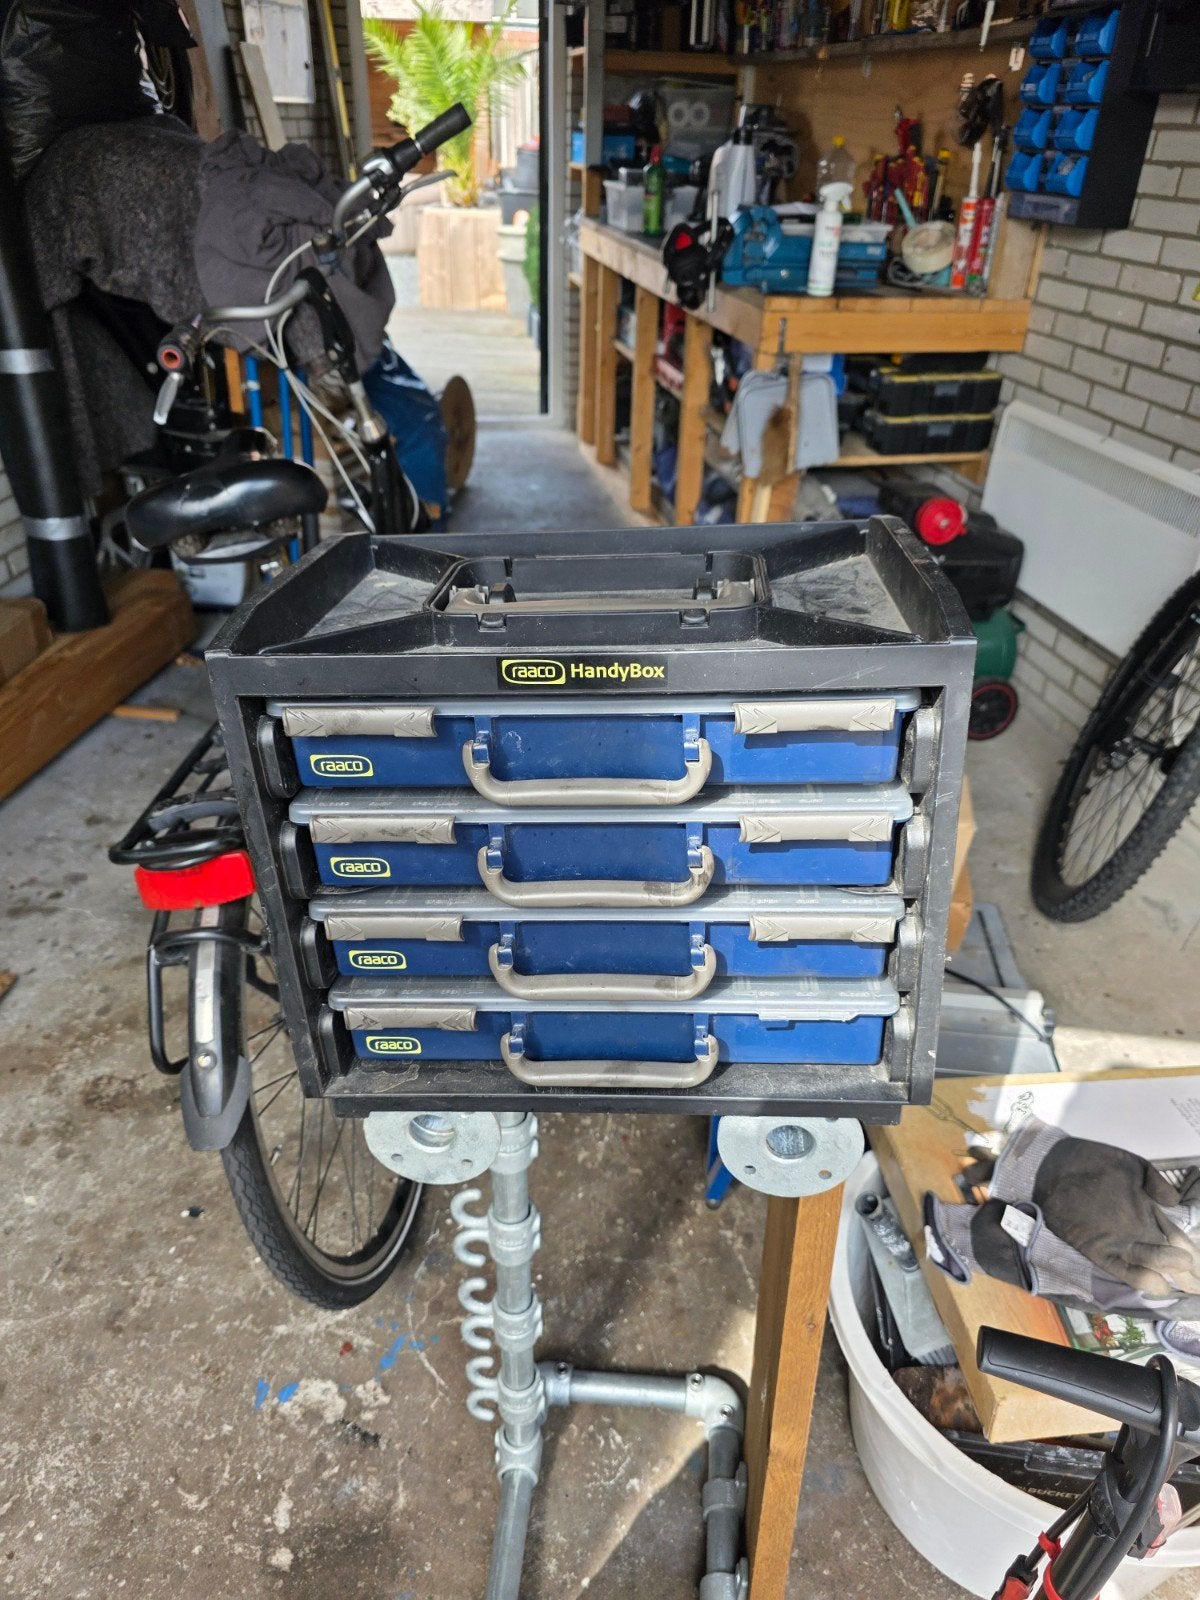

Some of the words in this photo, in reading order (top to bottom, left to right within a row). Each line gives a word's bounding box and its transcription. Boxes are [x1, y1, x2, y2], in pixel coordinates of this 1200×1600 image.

[511, 665, 557, 679] raaco
[570, 662, 665, 682] HandyBox
[319, 760, 364, 772] raaco
[339, 862, 382, 873] raaco
[357, 954, 399, 965] raaco
[373, 1040, 414, 1050] raaco
